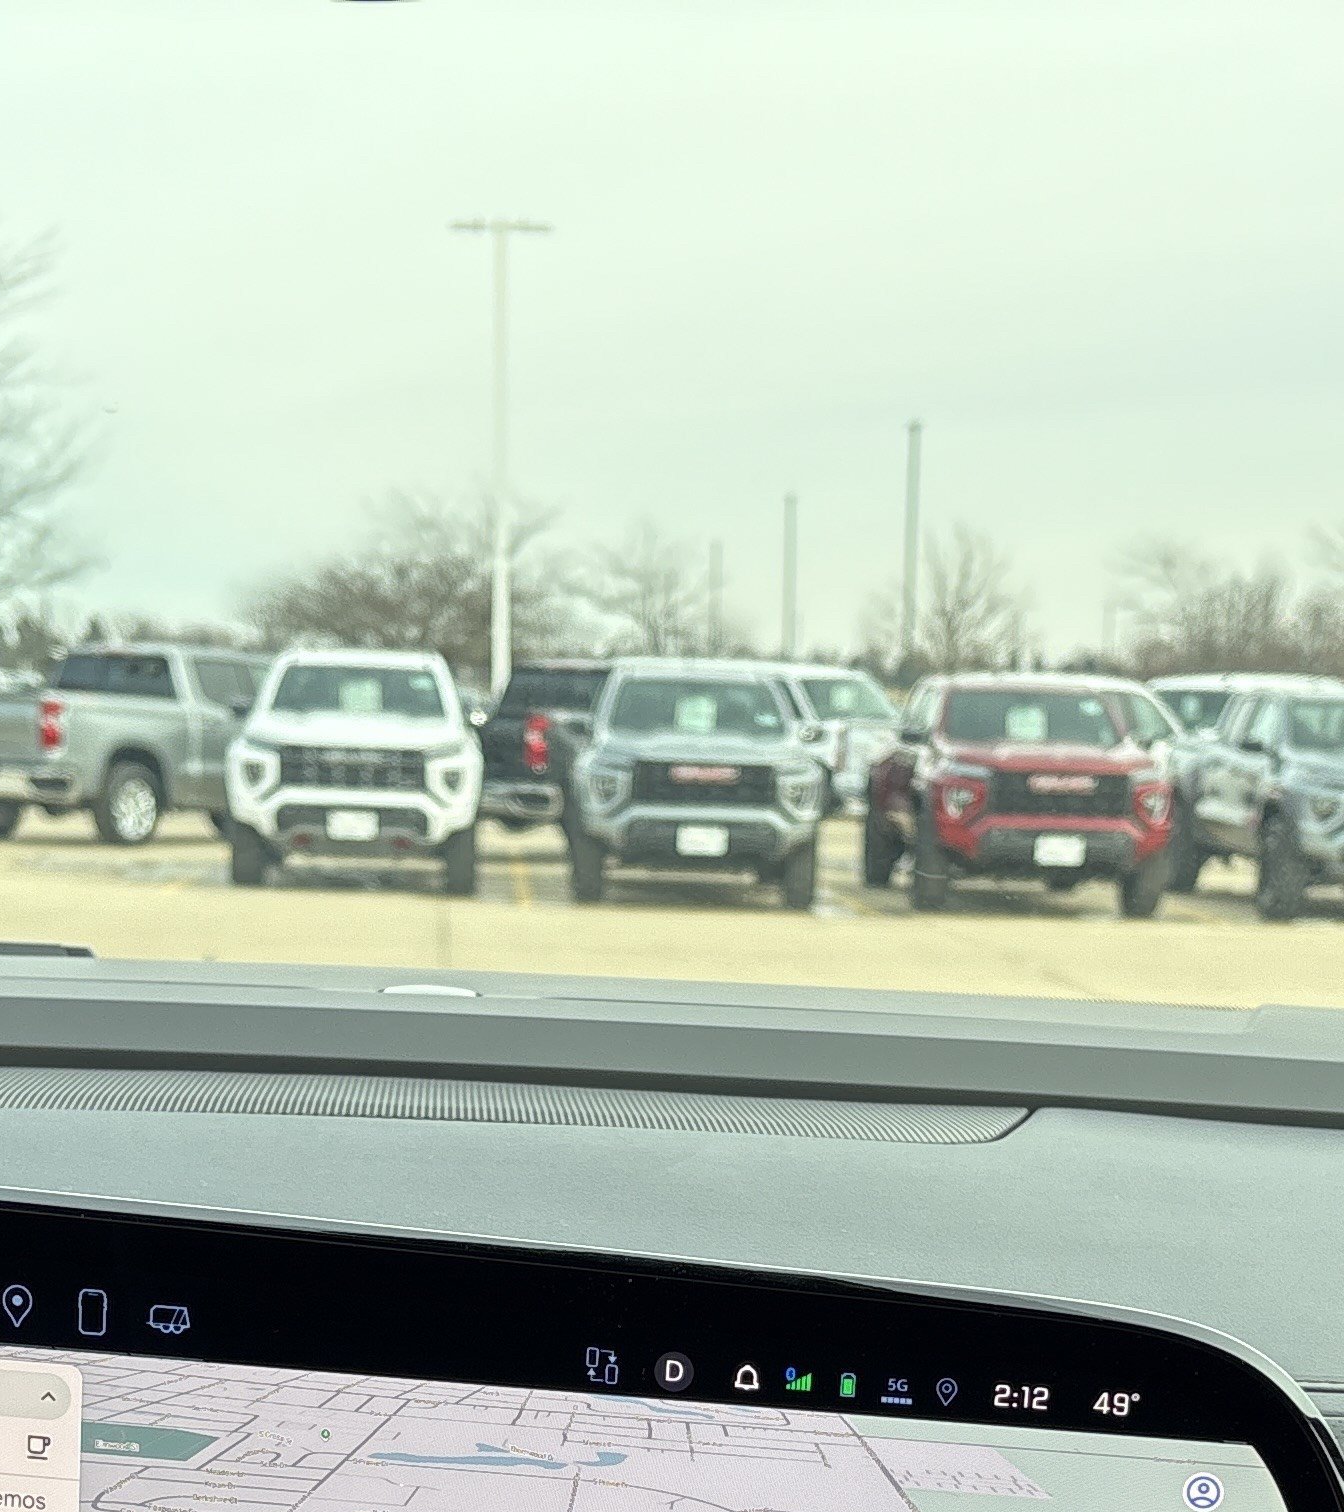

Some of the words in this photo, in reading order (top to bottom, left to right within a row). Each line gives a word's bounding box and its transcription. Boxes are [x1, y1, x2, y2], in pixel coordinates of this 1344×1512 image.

[665, 1360, 683, 1382] D
[888, 1378, 908, 1393] 5G
[994, 1384, 1049, 1411] 2:12
[1093, 1391, 1140, 1416] 49°
